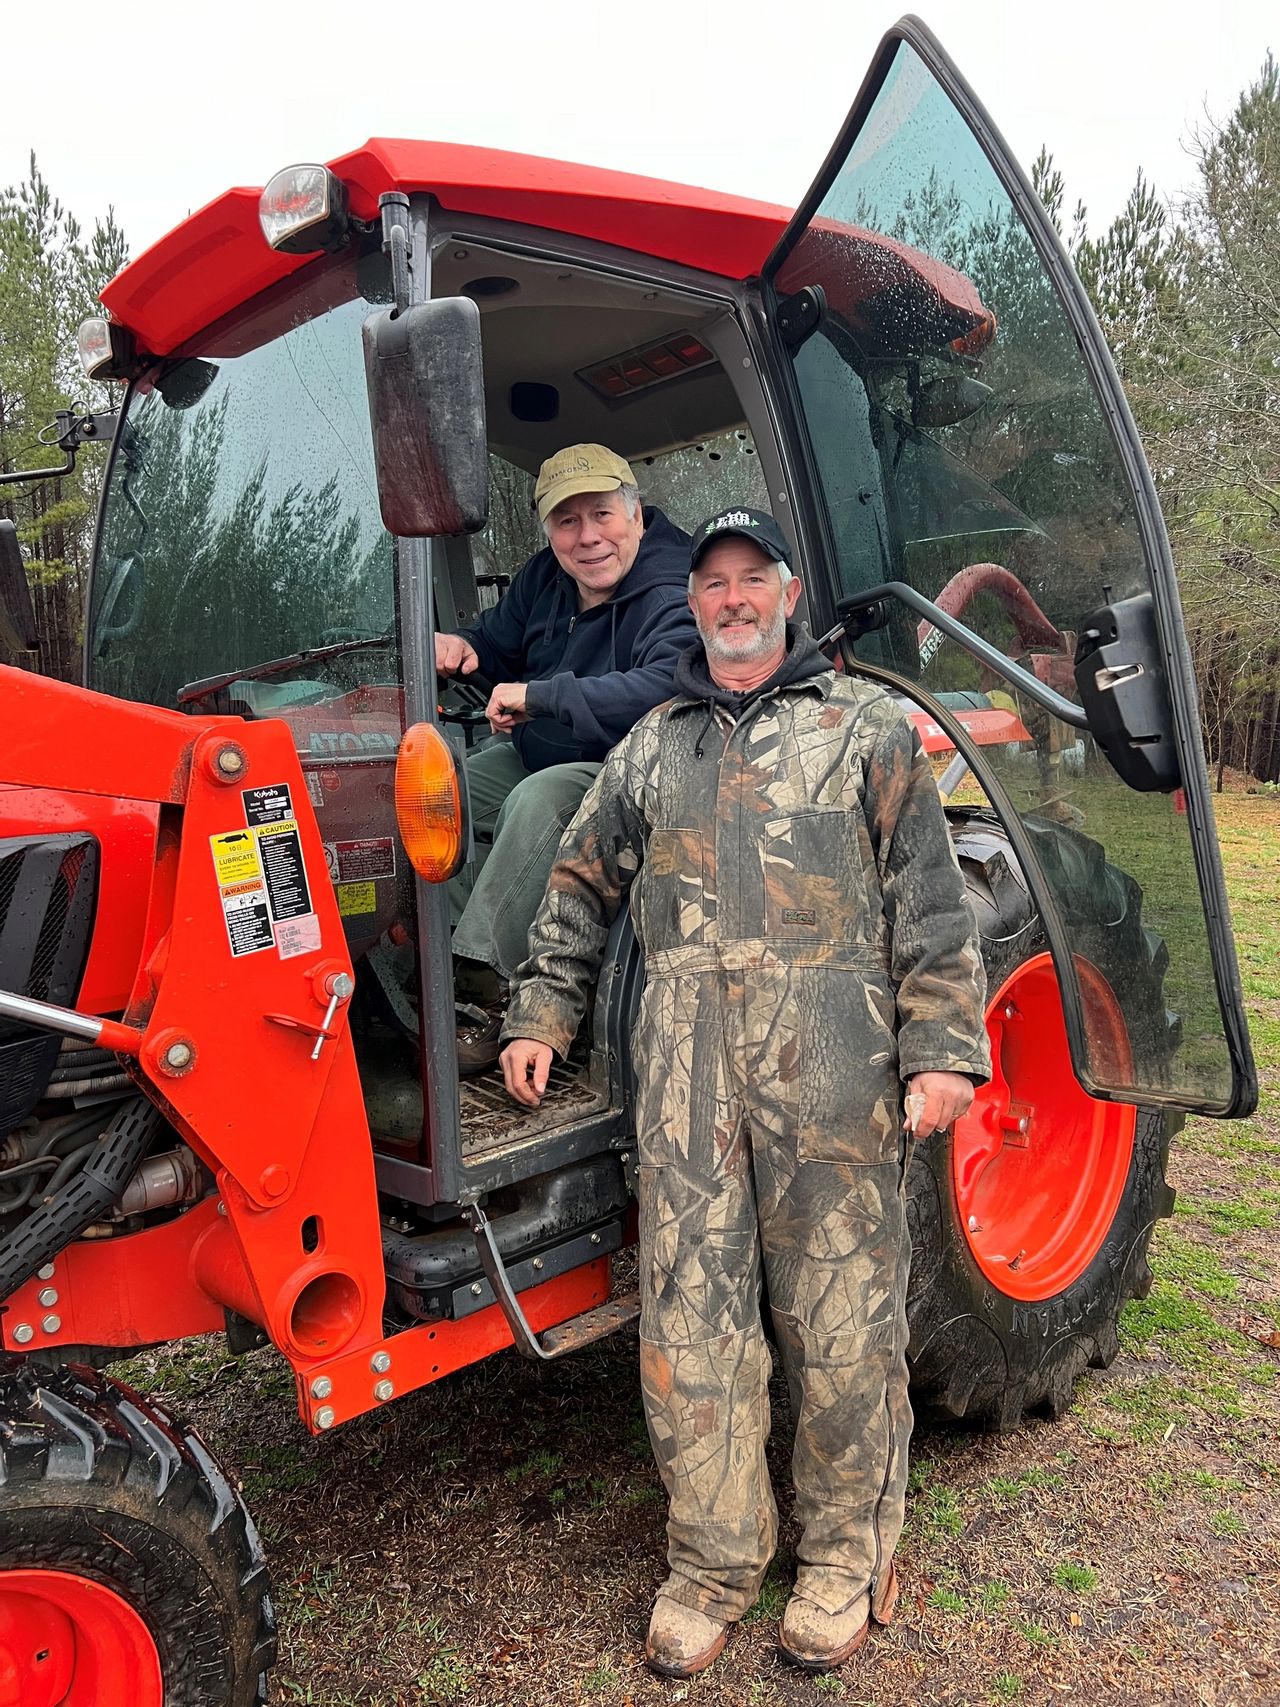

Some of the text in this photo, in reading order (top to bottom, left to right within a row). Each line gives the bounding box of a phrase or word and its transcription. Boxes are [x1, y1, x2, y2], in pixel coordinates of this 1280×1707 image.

[265, 823, 295, 834] CAUTION
[219, 853, 255, 866] LUBRICATE
[230, 883, 262, 895] WARNING
